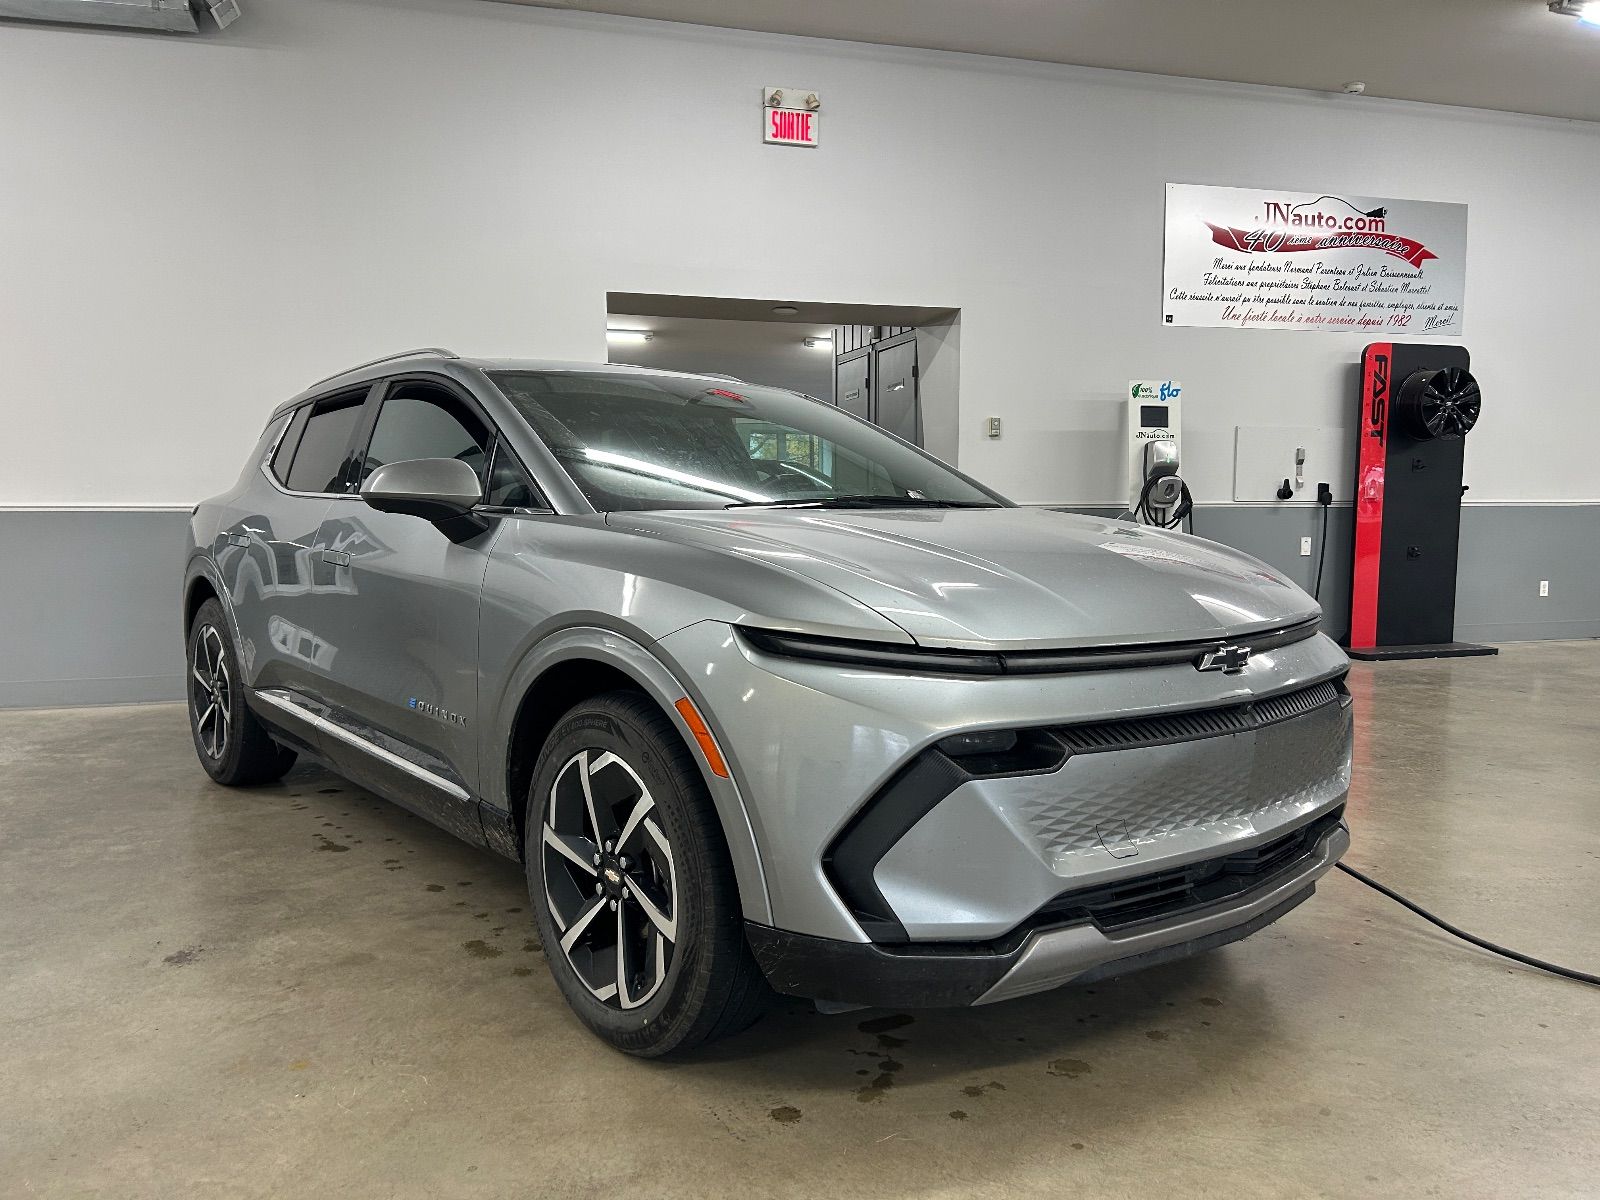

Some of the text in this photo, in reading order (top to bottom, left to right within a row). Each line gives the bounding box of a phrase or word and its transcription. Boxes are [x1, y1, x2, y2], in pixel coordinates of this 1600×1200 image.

[771, 110, 812, 142] SORTIE
[1255, 201, 1385, 232] JNauto.com
[1244, 228, 1410, 255] 40 ième anniversaire
[1213, 257, 1234, 270] Merci
[1248, 260, 1282, 275] fondateurs
[1284, 260, 1315, 273] Normand
[1347, 266, 1356, 275] et
[1203, 272, 1245, 287] Félicitations
[1258, 278, 1299, 291] propriétaires
[1301, 276, 1331, 292] Stéphane
[1361, 282, 1369, 291] et
[1369, 280, 1399, 293] Sébastien
[1169, 287, 1187, 300] Cette
[1188, 292, 1214, 301] réussite
[1214, 293, 1243, 302] n'aurait
[1241, 296, 1251, 306] pu
[1252, 294, 1265, 303] être
[1264, 293, 1291, 307] possible
[1307, 295, 1315, 305] le
[1315, 297, 1338, 306] soutien
[1338, 296, 1347, 306] de
[1437, 302, 1444, 311] et
[1221, 305, 1242, 320] Une
[1241, 307, 1269, 326] fierté
[1268, 309, 1295, 322] locale
[1296, 313, 1303, 322] à
[1327, 315, 1356, 325] service
[1357, 313, 1384, 329] depuis
[1387, 314, 1412, 326] 1982
[1424, 312, 1455, 328] Merci!
[1140, 380, 1182, 401] 100% flo
[1371, 354, 1389, 448] FAST
[1136, 431, 1175, 439] JNauto.com
[408, 696, 468, 728] EQUINOX
